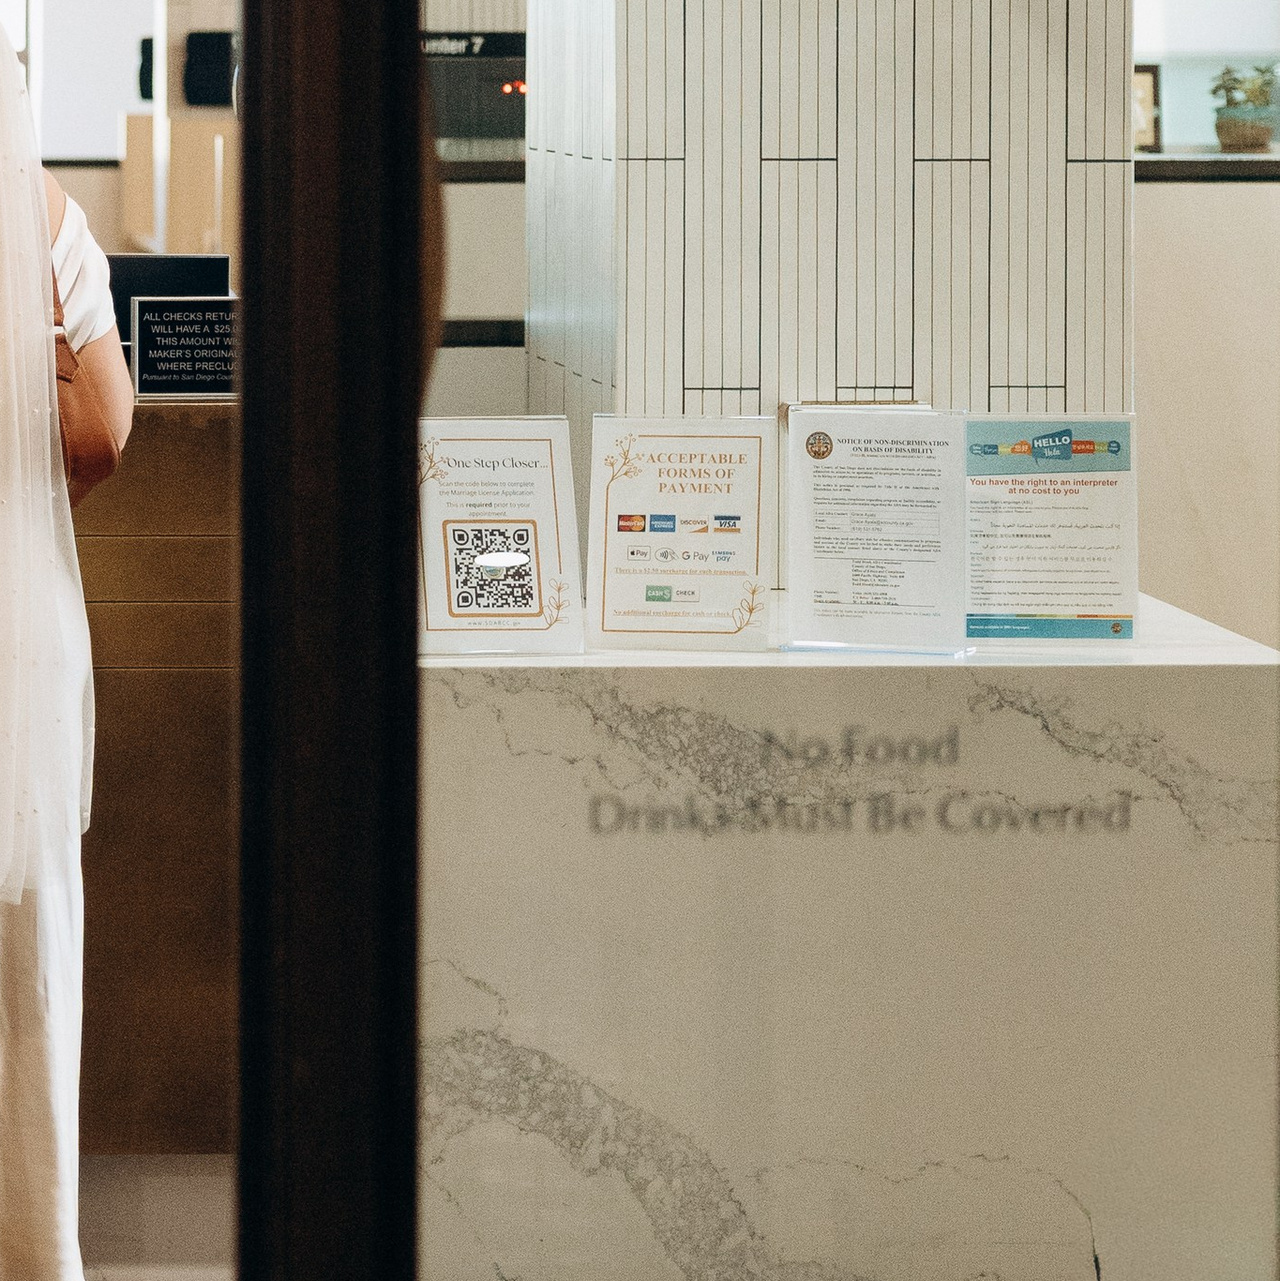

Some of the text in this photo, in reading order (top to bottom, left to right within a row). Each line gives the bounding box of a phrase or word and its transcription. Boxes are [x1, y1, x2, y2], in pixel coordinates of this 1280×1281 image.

[470, 36, 484, 54] 7
[143, 312, 161, 321] ALL
[163, 312, 203, 321] CHECKS
[151, 325, 173, 333] WILL
[176, 325, 201, 333] HAVE
[203, 325, 210, 333] A
[156, 337, 177, 346] THIS
[179, 337, 221, 346] AMOUNT
[148, 350, 192, 358] MAKER'S
[157, 362, 193, 370] WHERE
[1034, 436, 1070, 447] HELLO
[447, 457, 471, 468] One
[473, 458, 499, 471] Step
[647, 453, 748, 464] ACCEPTABLE
[658, 468, 735, 479] FORMS OF
[970, 478, 986, 486] You
[989, 478, 1009, 486] have
[1027, 479, 1047, 487] right
[1073, 479, 1118, 487] interpreter
[659, 483, 733, 494] PAYMENT
[682, 551, 710, 563] G Pay
[759, 724, 961, 767] No Food
[866, 793, 924, 833] Be
[936, 789, 1133, 834] Covered
